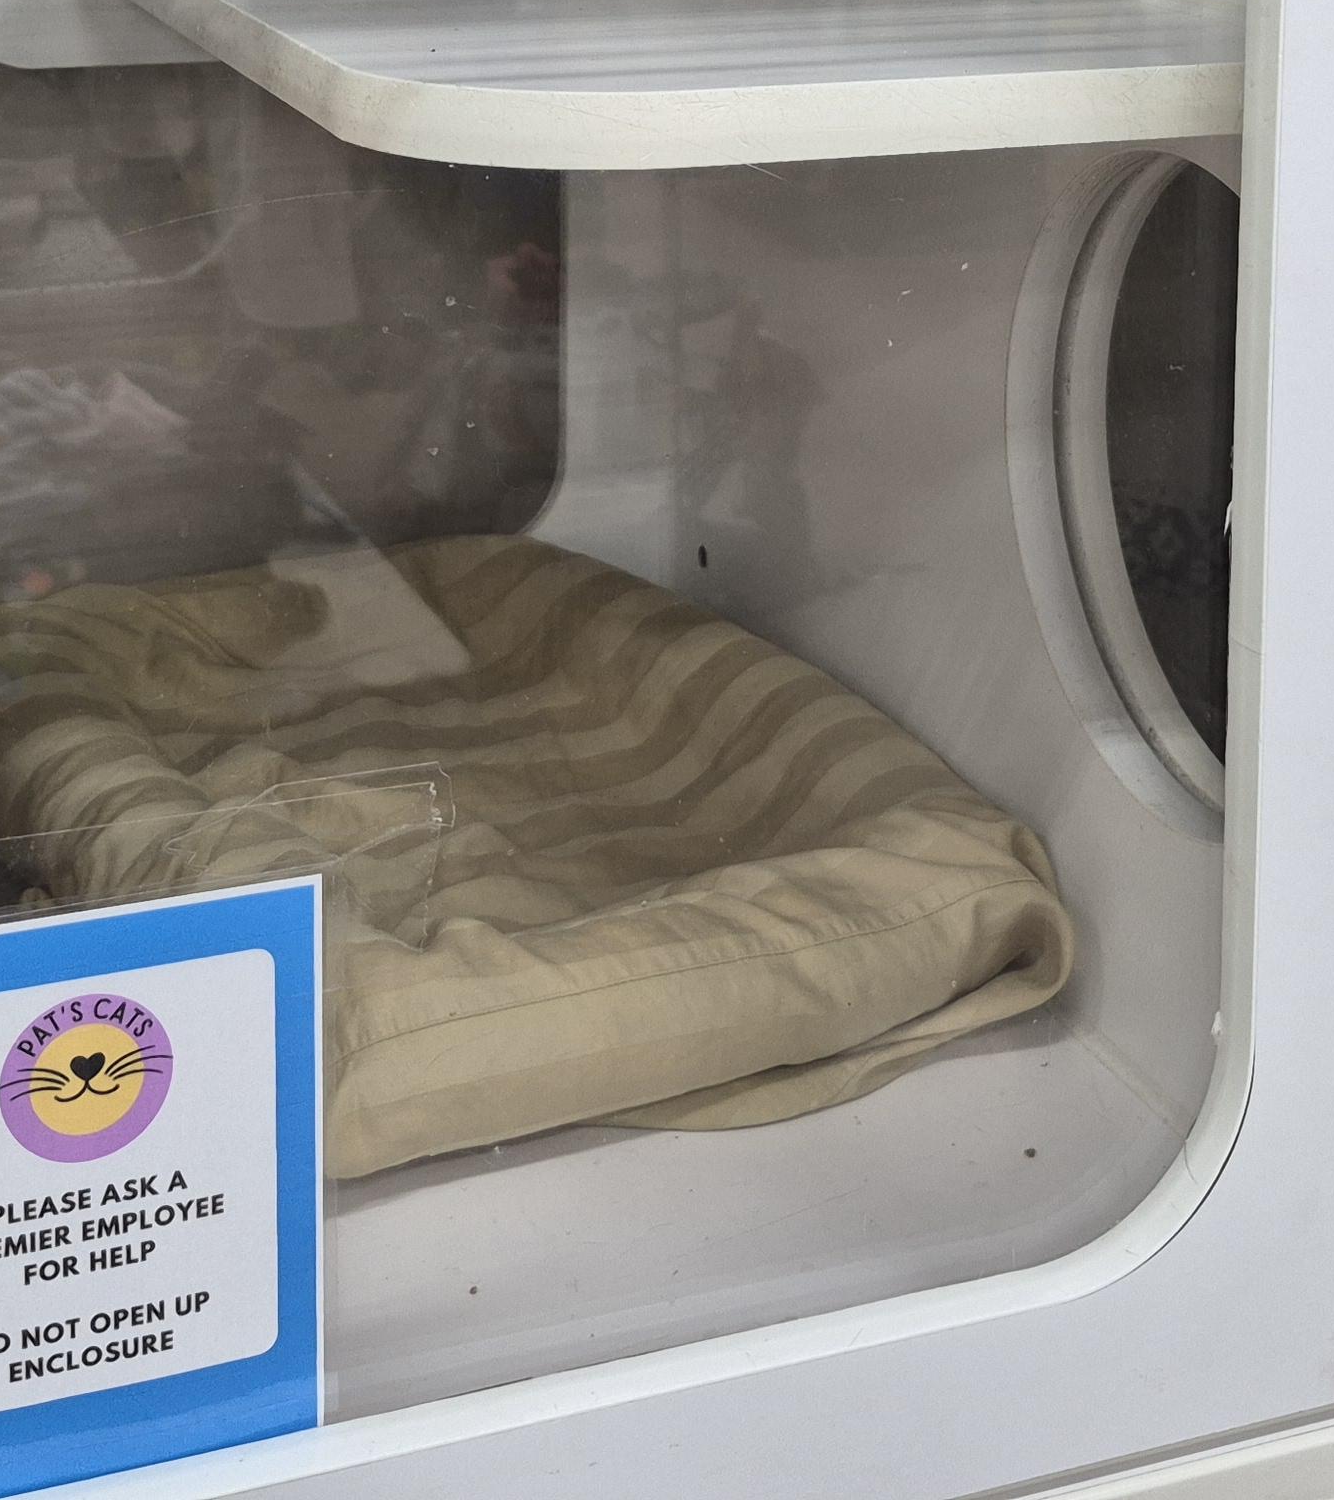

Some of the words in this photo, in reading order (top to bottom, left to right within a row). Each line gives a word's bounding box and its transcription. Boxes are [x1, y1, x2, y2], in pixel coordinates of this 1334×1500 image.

[17, 1001, 84, 1057] PAT'S
[93, 998, 154, 1037] CATS
[100, 1175, 159, 1207] ASK
[167, 1170, 188, 1193] A
[81, 1193, 226, 1241] EMPLOYEE
[23, 1256, 80, 1286] FOR
[89, 1240, 157, 1273] HELP
[20, 1318, 80, 1350] NOT
[89, 1299, 165, 1334] OPEN
[174, 1290, 211, 1316] UP
[7, 1329, 175, 1384] ENCLOSURE
